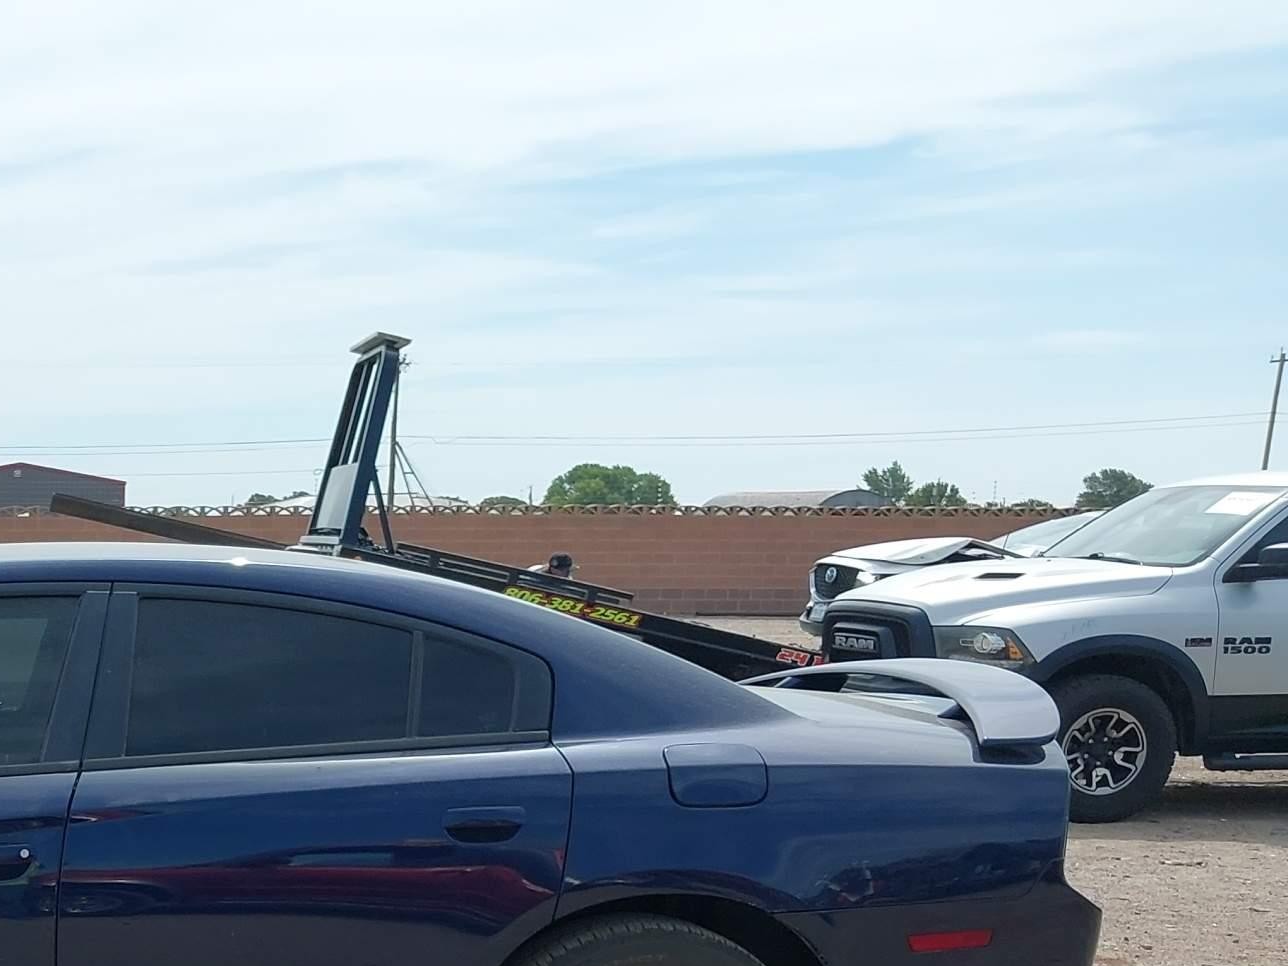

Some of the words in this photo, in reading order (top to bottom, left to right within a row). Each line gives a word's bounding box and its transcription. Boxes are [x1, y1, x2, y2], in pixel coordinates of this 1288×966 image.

[504, 587, 640, 626] 806-381-2561
[834, 636, 874, 650] RAM
[1223, 637, 1272, 645] RAM
[776, 648, 810, 666] 24
[1223, 646, 1271, 655] 1500
